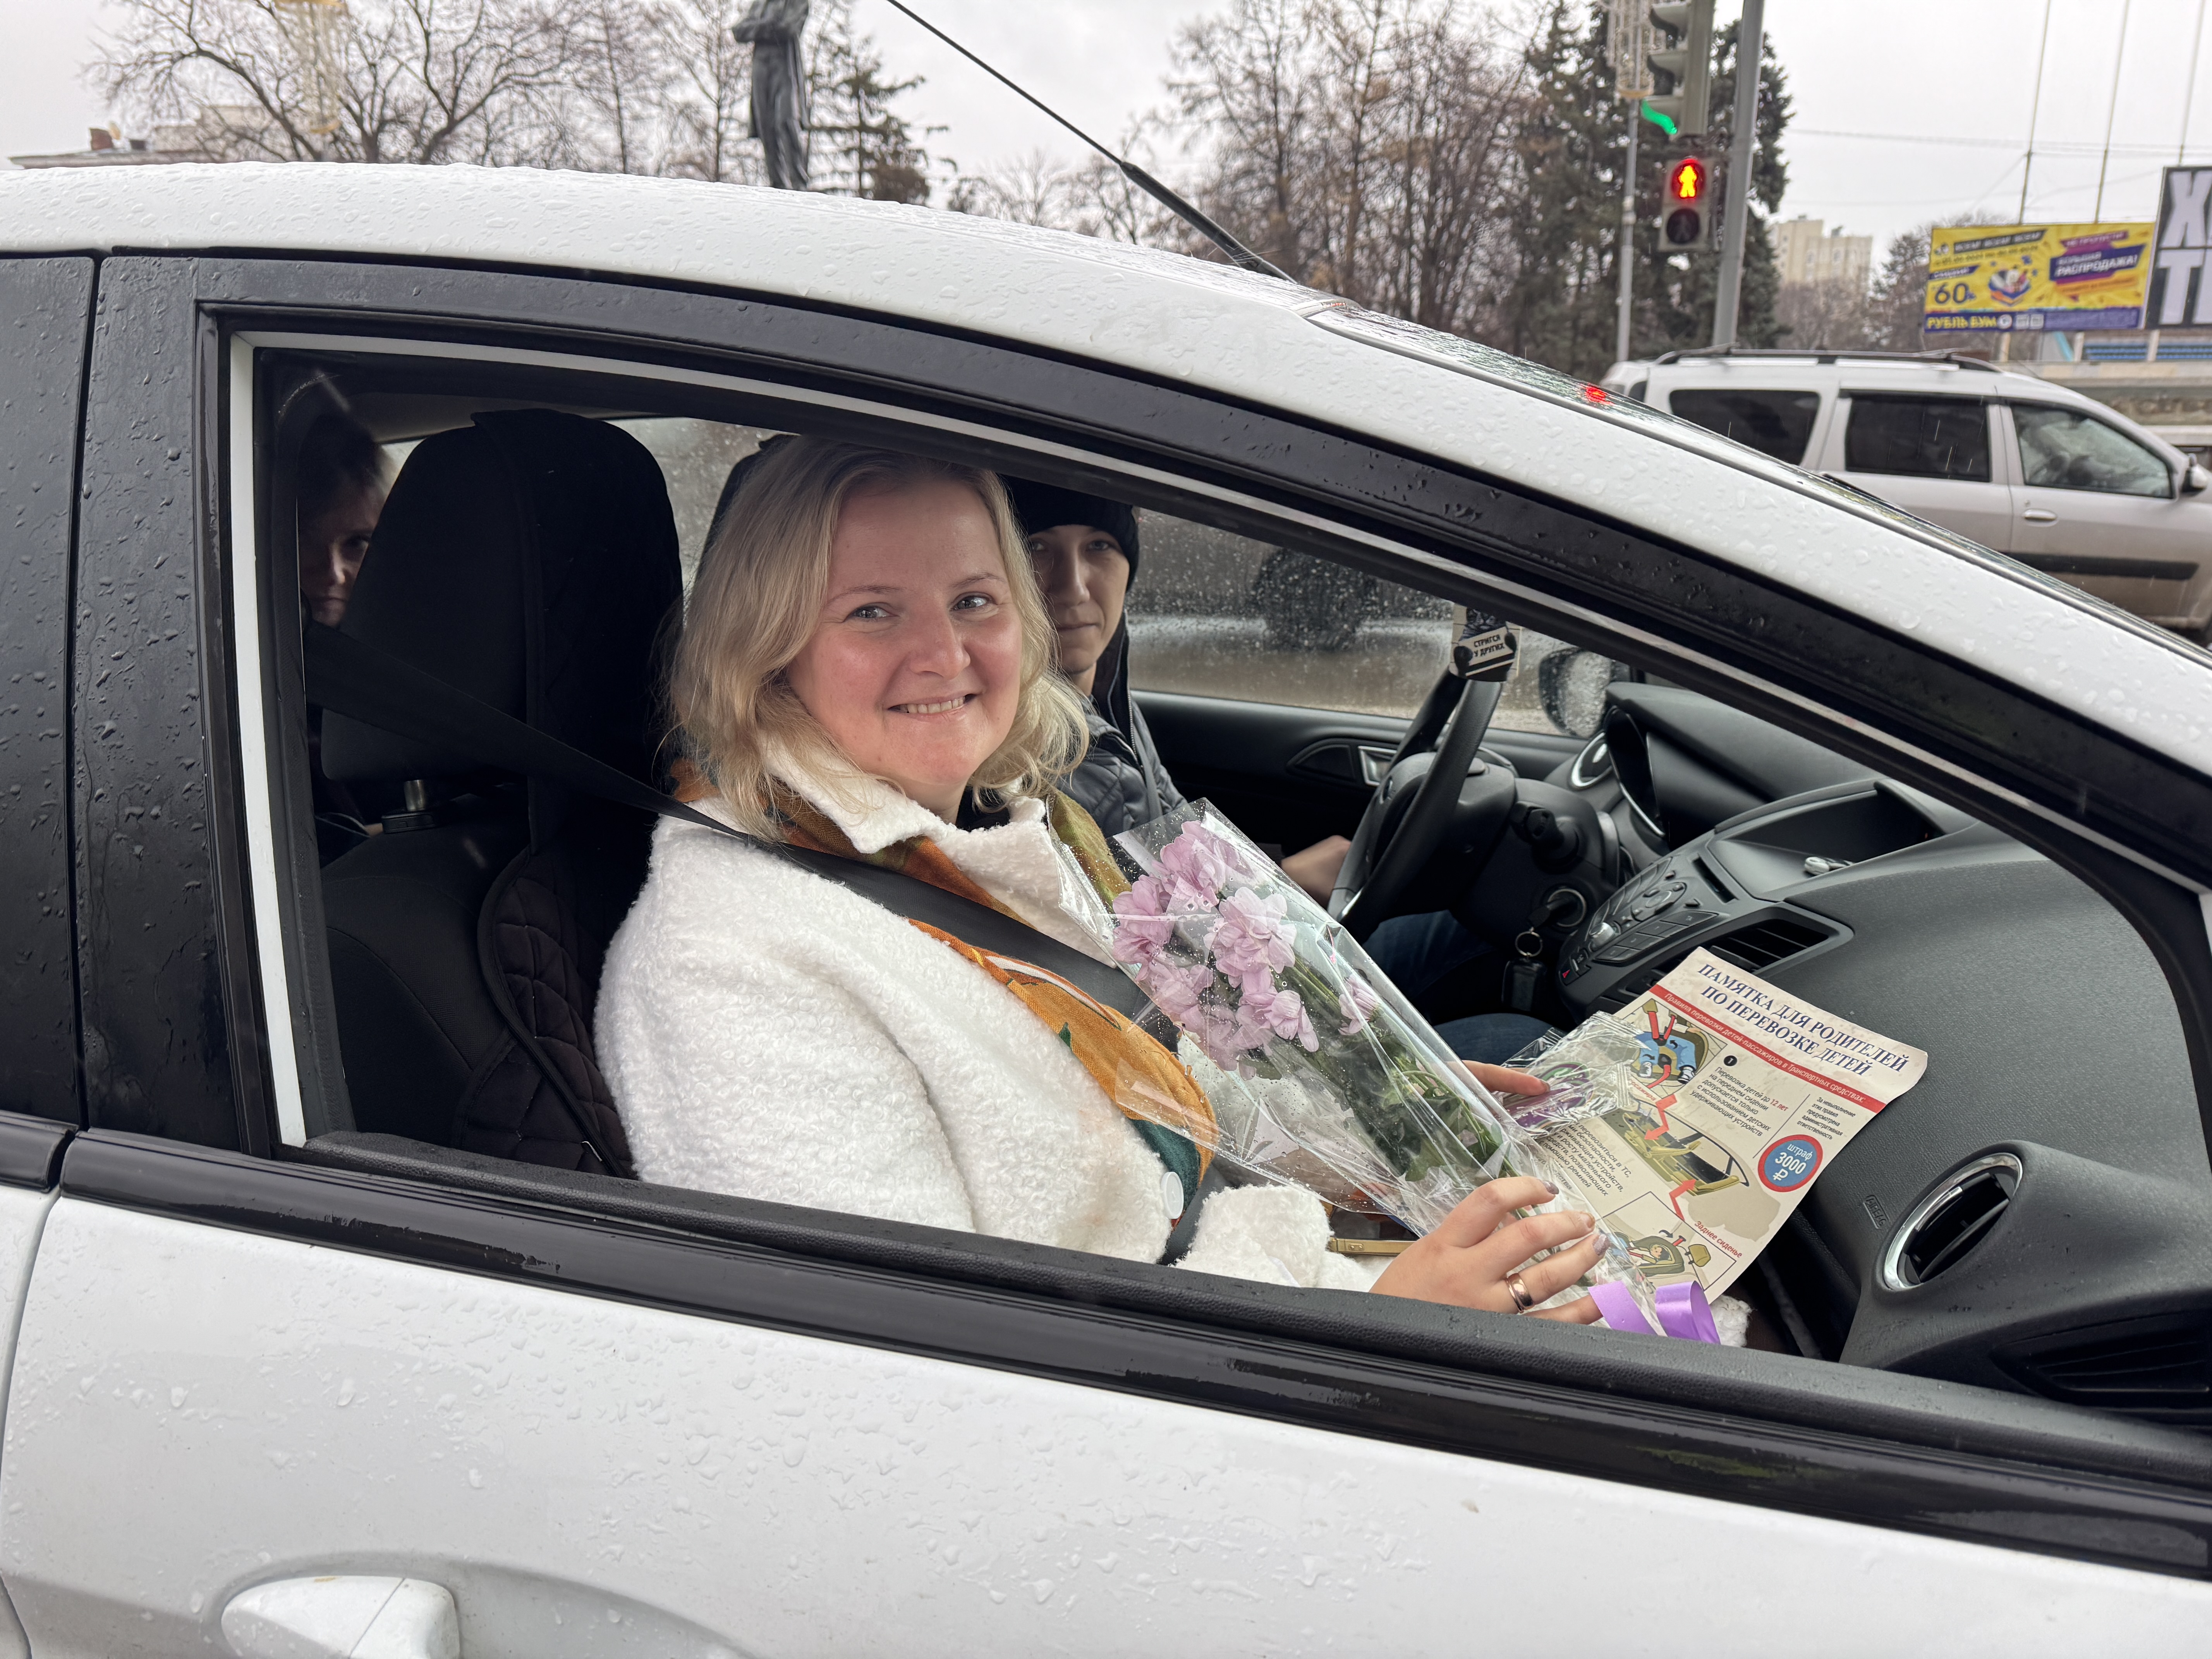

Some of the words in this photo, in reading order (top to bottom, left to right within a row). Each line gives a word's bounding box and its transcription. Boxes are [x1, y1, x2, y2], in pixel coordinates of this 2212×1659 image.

[2054, 254, 2138, 277] РАСПРОДАЖА!
[1474, 634, 1501, 647] СТРИГСЯ
[1480, 643, 1505, 657] ДРУГИХ
[1697, 963, 1774, 1011] ПАМЯТКА
[1770, 1005, 1813, 1028] ДЛЯ
[1808, 1021, 1909, 1072] РОДИТЕЛЕЙ
[1701, 986, 1728, 1004] ПО
[1725, 1000, 1819, 1054] ПЕРЕВОЗКЕ
[1812, 1048, 1873, 1075] ДЕТЕЙ
[1664, 993, 1692, 1012] Правила
[1691, 1010, 1724, 1031] перевозки
[1723, 1029, 1783, 1065] детей-пассажиров
[1787, 1064, 1830, 1087] Транспортных
[1830, 1084, 1866, 1103] средствах:
[1702, 1079, 1739, 1103] допускается
[1739, 1101, 1759, 1115] только
[1715, 1066, 1746, 1088] Перевозка
[1745, 1087, 1763, 1098] детей
[1717, 1078, 1746, 1097] переднем
[1745, 1096, 1769, 1111] сидении
[1690, 1090, 1735, 1120] удерживающих
[1732, 1117, 1763, 1137] устройств
[1702, 1087, 1748, 1118] использованием
[1747, 1116, 1771, 1132] детских
[1807, 1109, 1840, 1127] предусмотрена
[1822, 1100, 1856, 1117] невыполнение
[1822, 1108, 1839, 1118] правил
[1797, 1121, 1833, 1140] ответственность
[1802, 1115, 1843, 1136] административная
[1543, 1142, 1570, 1166] помощью
[1568, 1165, 1592, 1188] ремней
[1561, 1138, 1579, 1153] росту
[1578, 1153, 1611, 1188] маленького
[1577, 1132, 1616, 1172] безопасности,
[1578, 1124, 1618, 1162] перевозиться
[1621, 1166, 1632, 1178] ТС,
[1775, 1152, 1807, 1174] 3000
[1787, 1144, 1813, 1161] штраф
[1568, 1154, 1609, 1196] позволяющих
[1593, 1159, 1624, 1192] устройств,
[1694, 1221, 1717, 1240] Заднее
[1716, 1238, 1743, 1258] сиденье
